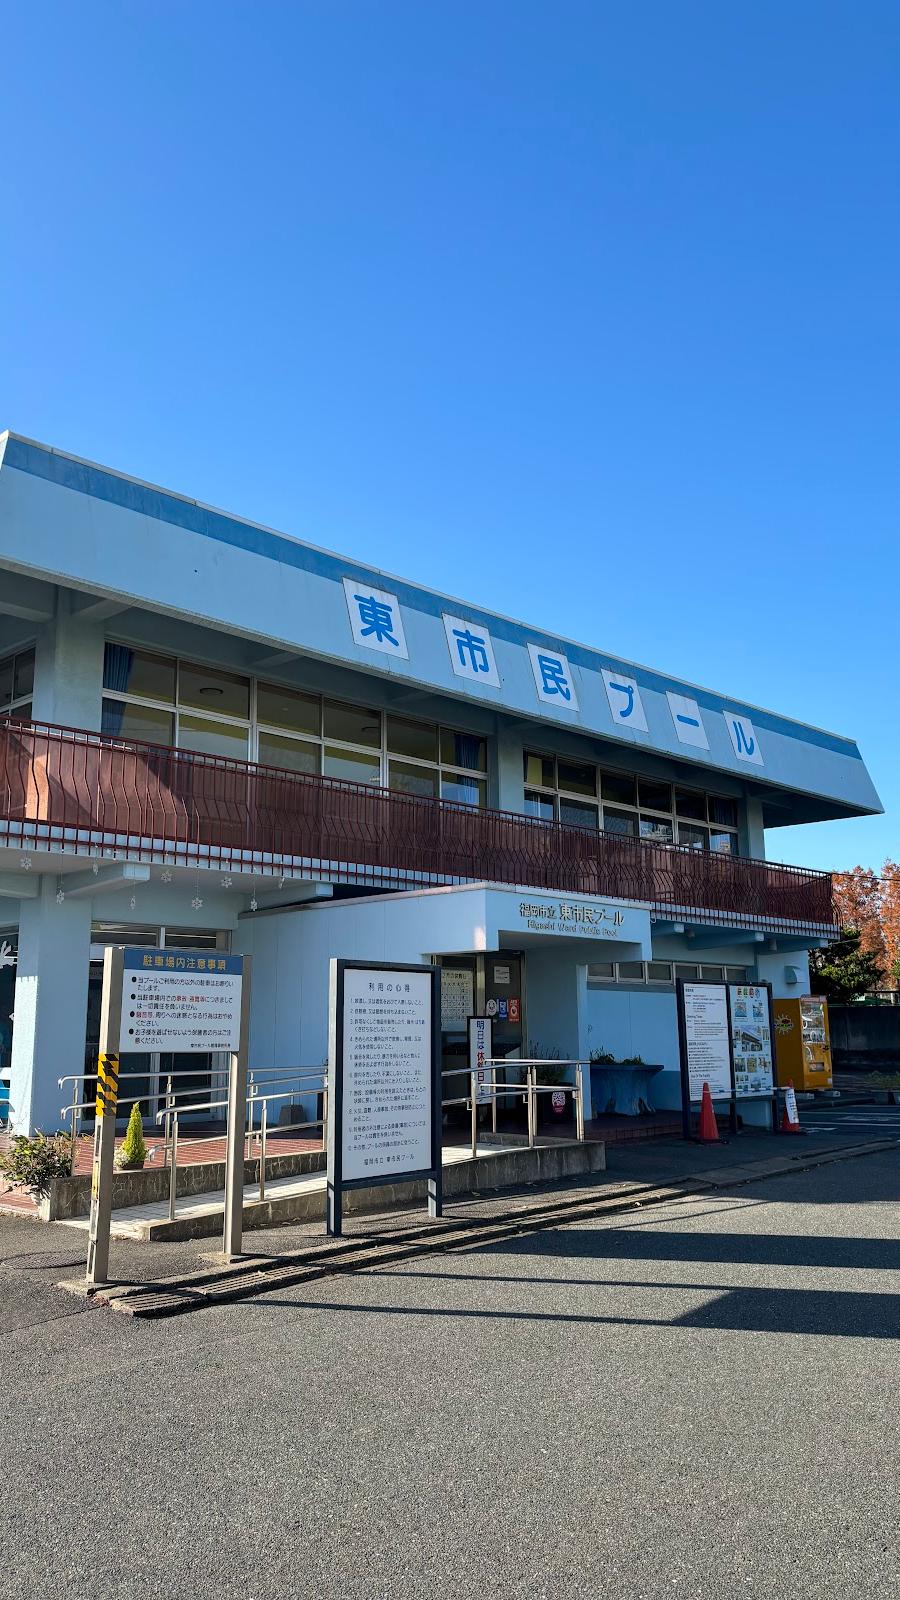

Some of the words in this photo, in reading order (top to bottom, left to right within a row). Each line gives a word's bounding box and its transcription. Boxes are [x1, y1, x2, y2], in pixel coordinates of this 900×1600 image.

[354, 594, 754, 756] 東市民プール
[519, 902, 557, 919] 福岡市立
[559, 903, 625, 926] 東市民プール
[143, 954, 226, 970] 駐車場内注意事項
